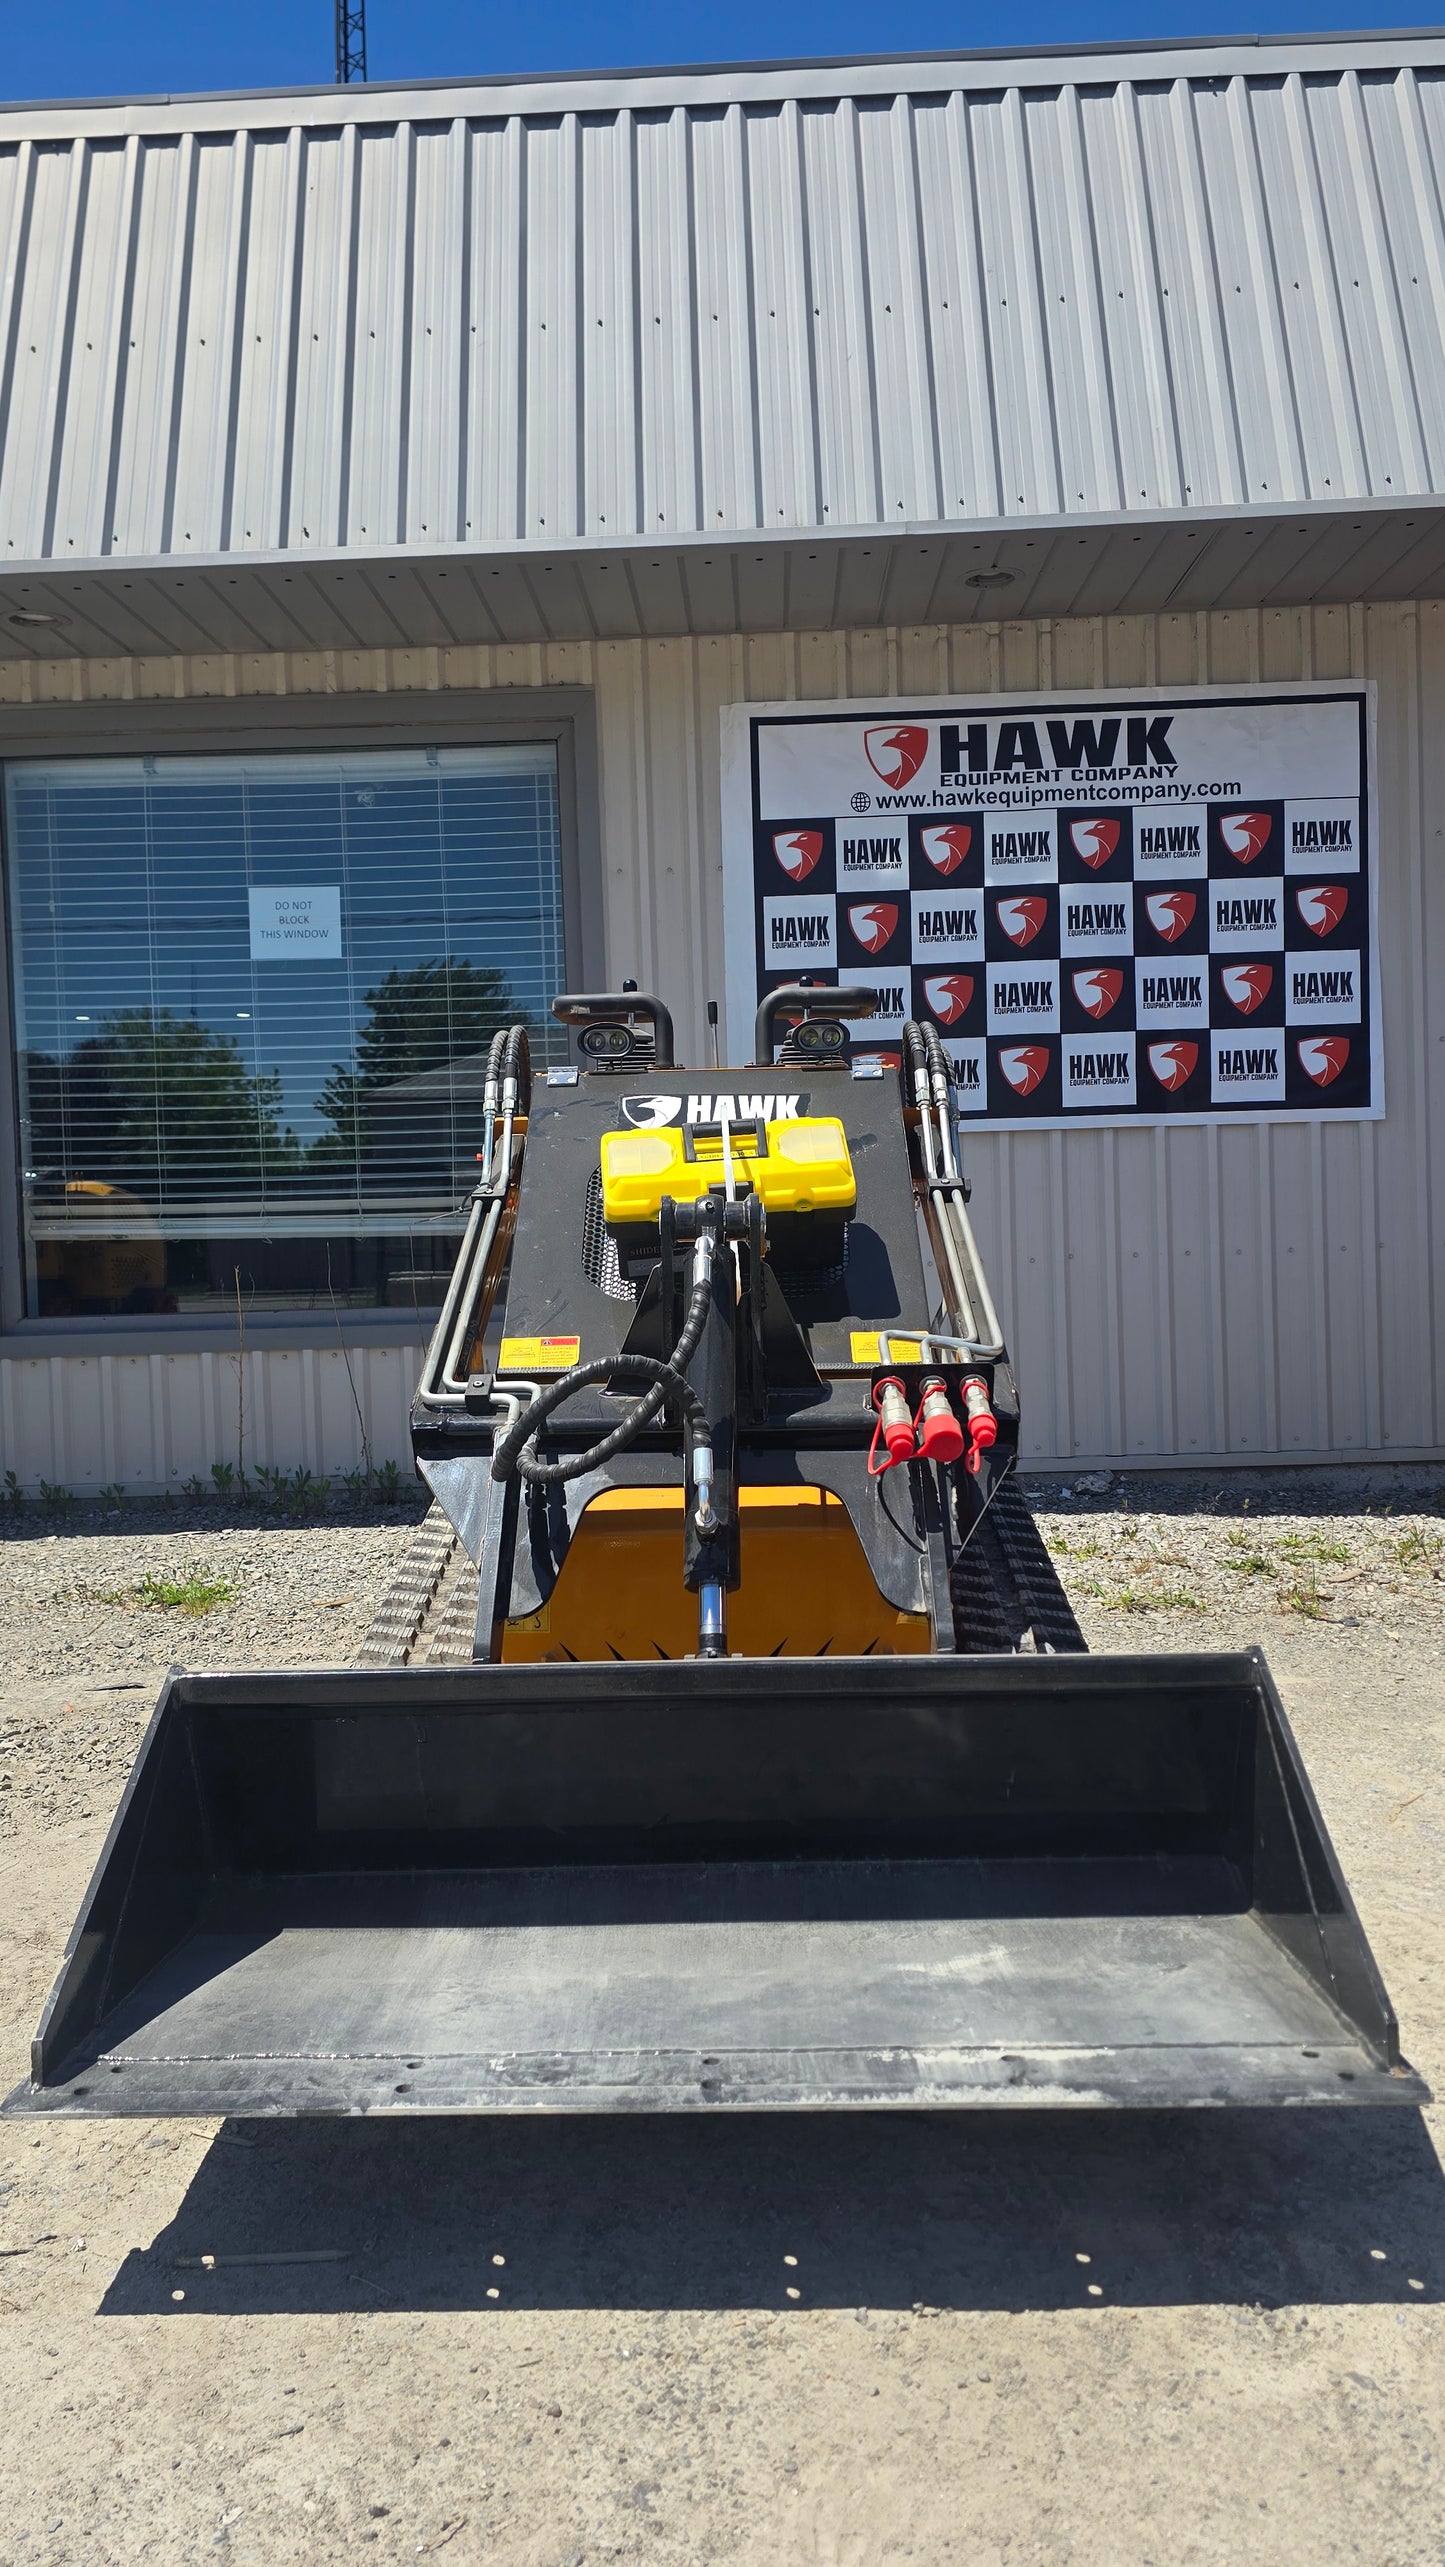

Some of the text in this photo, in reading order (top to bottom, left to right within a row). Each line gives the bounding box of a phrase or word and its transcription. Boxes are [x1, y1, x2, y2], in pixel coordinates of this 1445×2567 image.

[939, 716, 1178, 773] HAWK
[940, 765, 1179, 787] EQUIPMENT COMPANY
[876, 780, 1241, 810] www.hawkequipmentcompany.com
[991, 831, 1051, 857] HAWK
[1140, 826, 1200, 852] HAWK
[1292, 820, 1352, 846] HAWK
[843, 838, 902, 864] HAWK
[991, 857, 1022, 865] EQUIPMENT
[1140, 852, 1171, 860] EQUIPMENT
[843, 862, 903, 872] EQUIPMENT COMPANY
[275, 901, 312, 910] DO NOT
[1067, 904, 1127, 929] HAWK
[1216, 899, 1276, 925] HAWK
[279, 915, 310, 924] BLOCK
[771, 916, 830, 942] HAWK
[918, 910, 978, 936] HAWK
[1249, 923, 1277, 931] COMPANY
[260, 929, 329, 939] THIS WINDOW
[1067, 928, 1127, 937] EQUIPMENT COMPANY
[994, 981, 1053, 1007] HAWK
[1142, 976, 1201, 1002] HAWK
[1293, 971, 1353, 998] HAWK
[994, 1007, 1025, 1015] EQUIPMENT
[1143, 1000, 1203, 1009] EQUIPMENT COMPANY
[1293, 995, 1354, 1005] EQUIPMENT COMPANY
[1069, 1053, 1129, 1079] HAWK
[1218, 1049, 1277, 1074] HAWK
[1102, 1077, 1130, 1085] COMPANY
[1218, 1074, 1249, 1082] EQUIPMENT
[686, 1094, 801, 1124] HAWK
